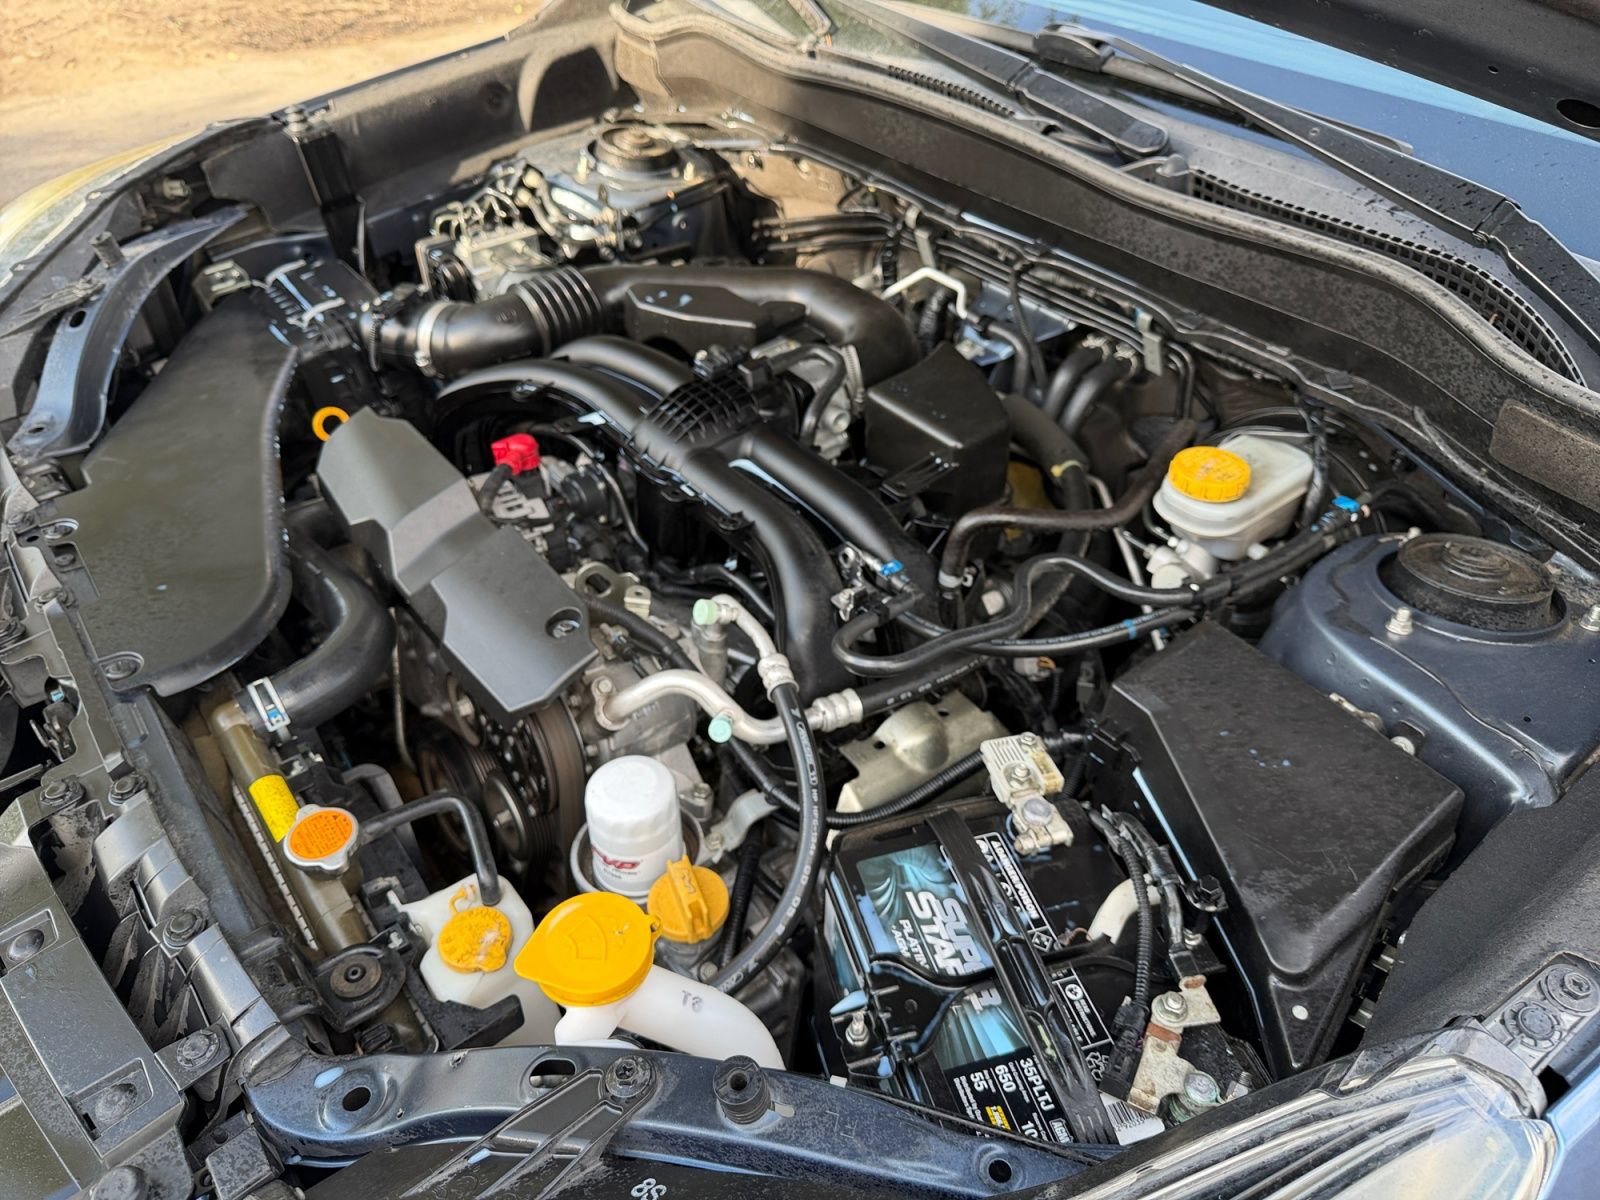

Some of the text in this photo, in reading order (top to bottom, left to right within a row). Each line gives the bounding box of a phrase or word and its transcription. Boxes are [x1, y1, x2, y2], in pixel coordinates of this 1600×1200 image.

[970, 1071, 988, 1092] 55
[995, 1064, 1017, 1093] 650
[1020, 1058, 1055, 1111] 35PLTJ
